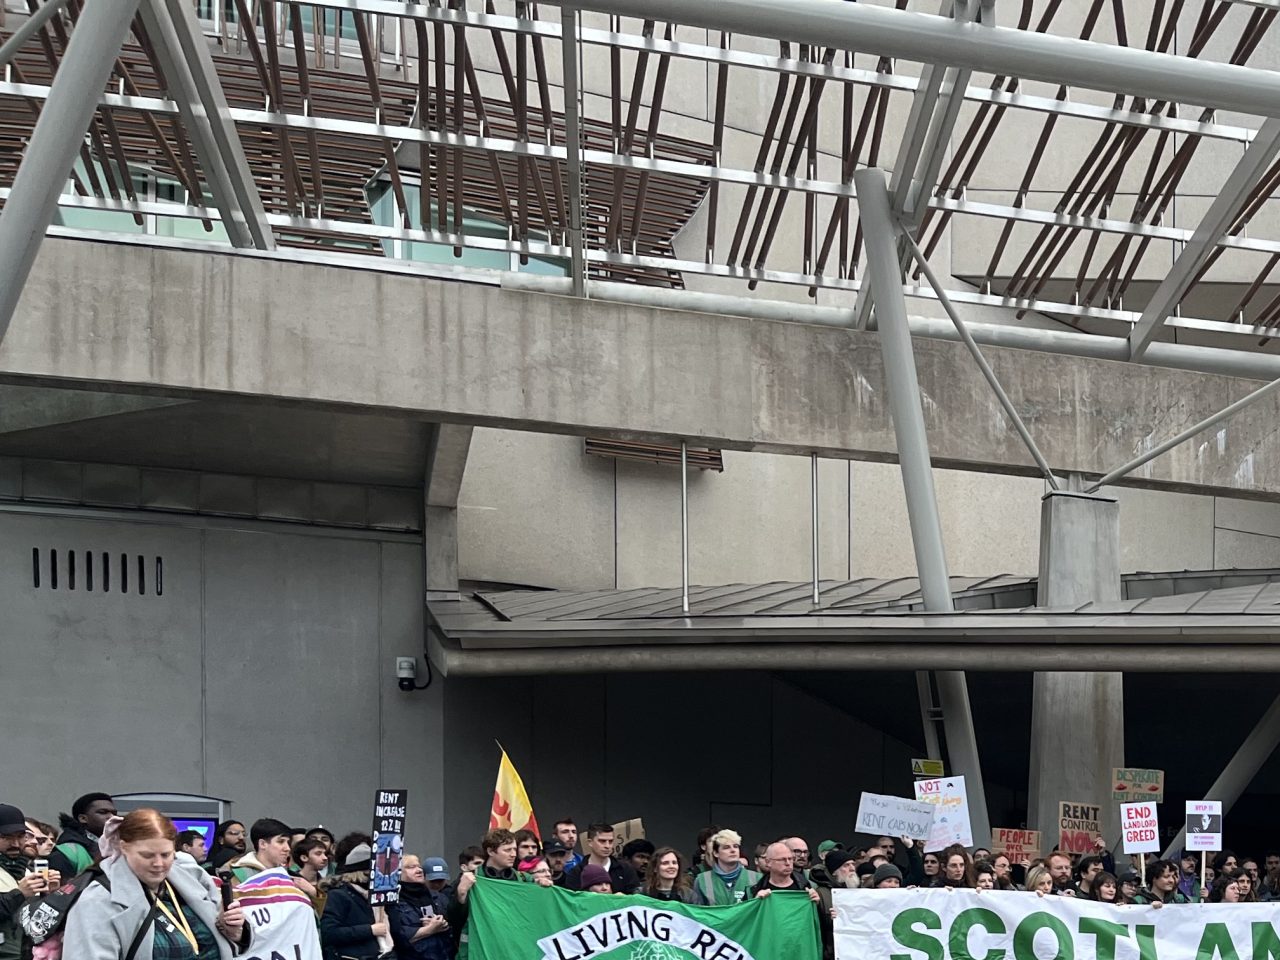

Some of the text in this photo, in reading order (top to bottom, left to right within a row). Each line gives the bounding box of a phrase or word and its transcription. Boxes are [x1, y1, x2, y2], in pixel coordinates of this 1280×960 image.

[919, 781, 941, 793] NOT
[380, 791, 399, 804] RENT
[376, 805, 405, 817] INCREASE
[1063, 803, 1100, 821] RENT
[1126, 807, 1151, 820] END
[862, 812, 886, 830] RENT
[1060, 818, 1101, 832] CONTROL
[1123, 819, 1156, 830] LANDLORD
[999, 829, 1034, 845] PEOPLE
[1126, 829, 1155, 842] GREED
[1004, 851, 1030, 864] OFIT
